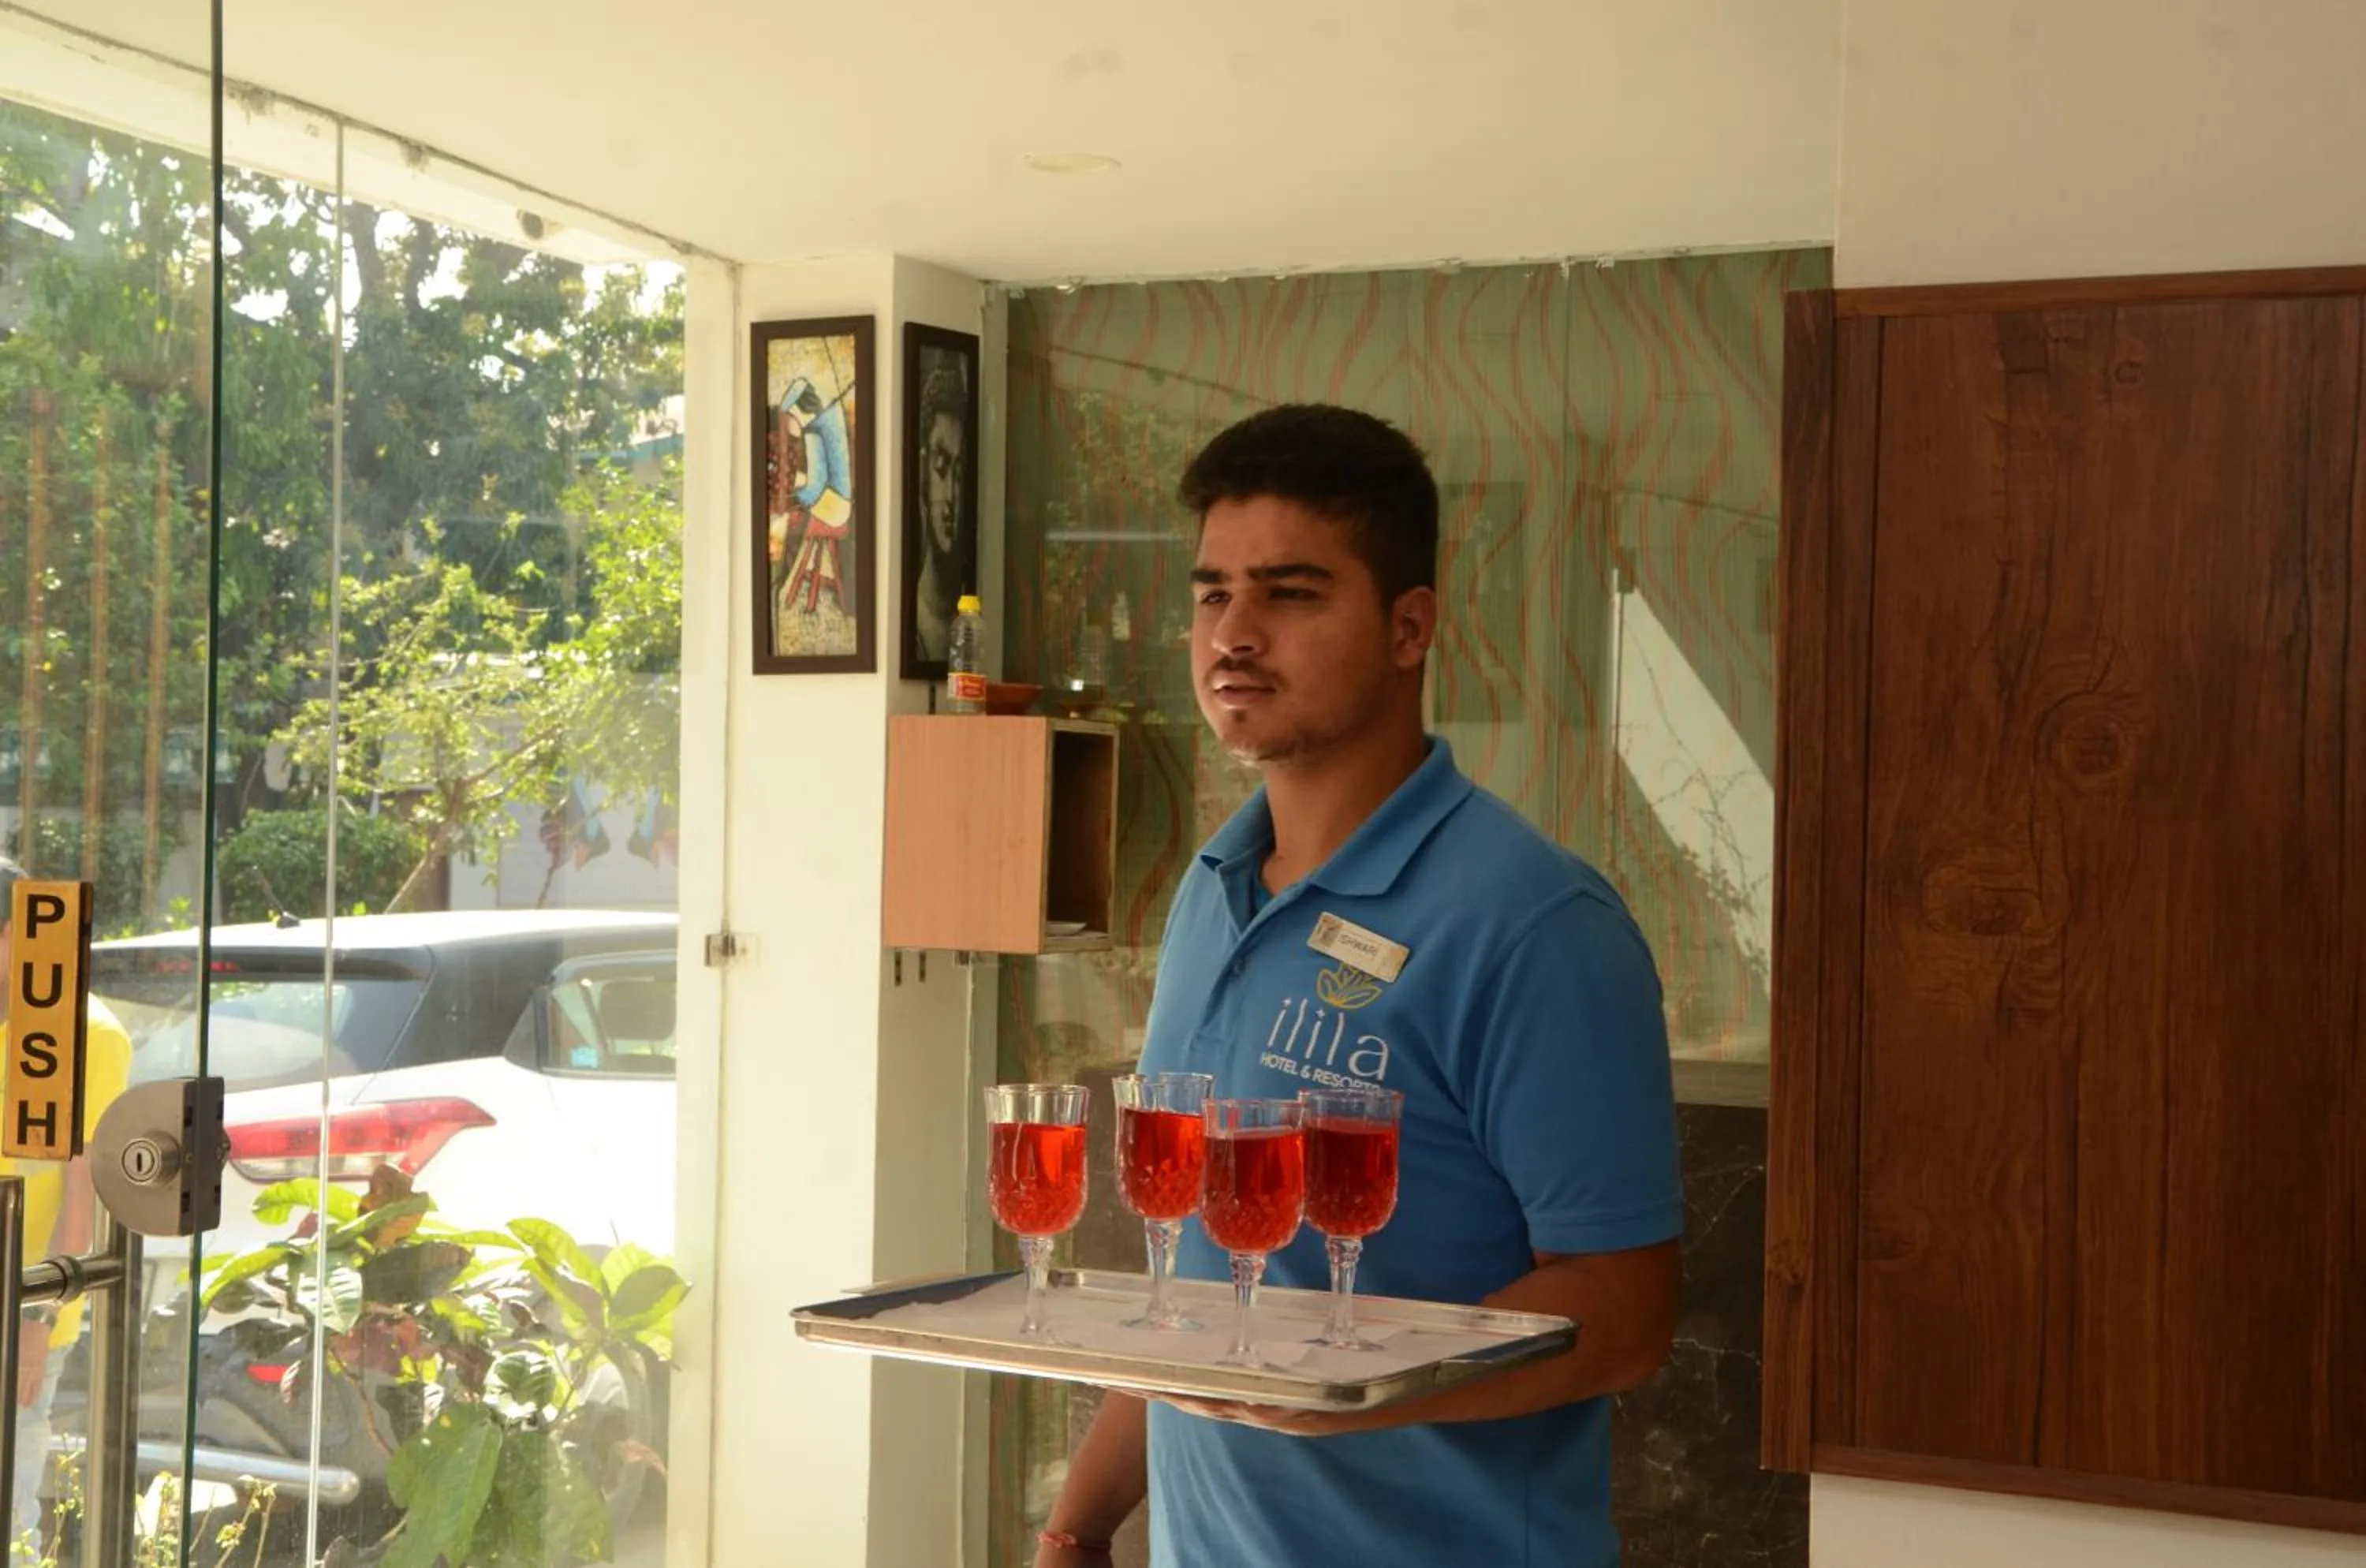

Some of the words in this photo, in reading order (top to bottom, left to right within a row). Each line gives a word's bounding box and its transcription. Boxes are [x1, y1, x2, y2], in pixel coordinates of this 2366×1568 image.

[17, 894, 66, 1147] PUSH
[1267, 996, 1390, 1081] ilila
[1260, 1051, 1298, 1075] HOTEL
[1300, 1064, 1312, 1079] &
